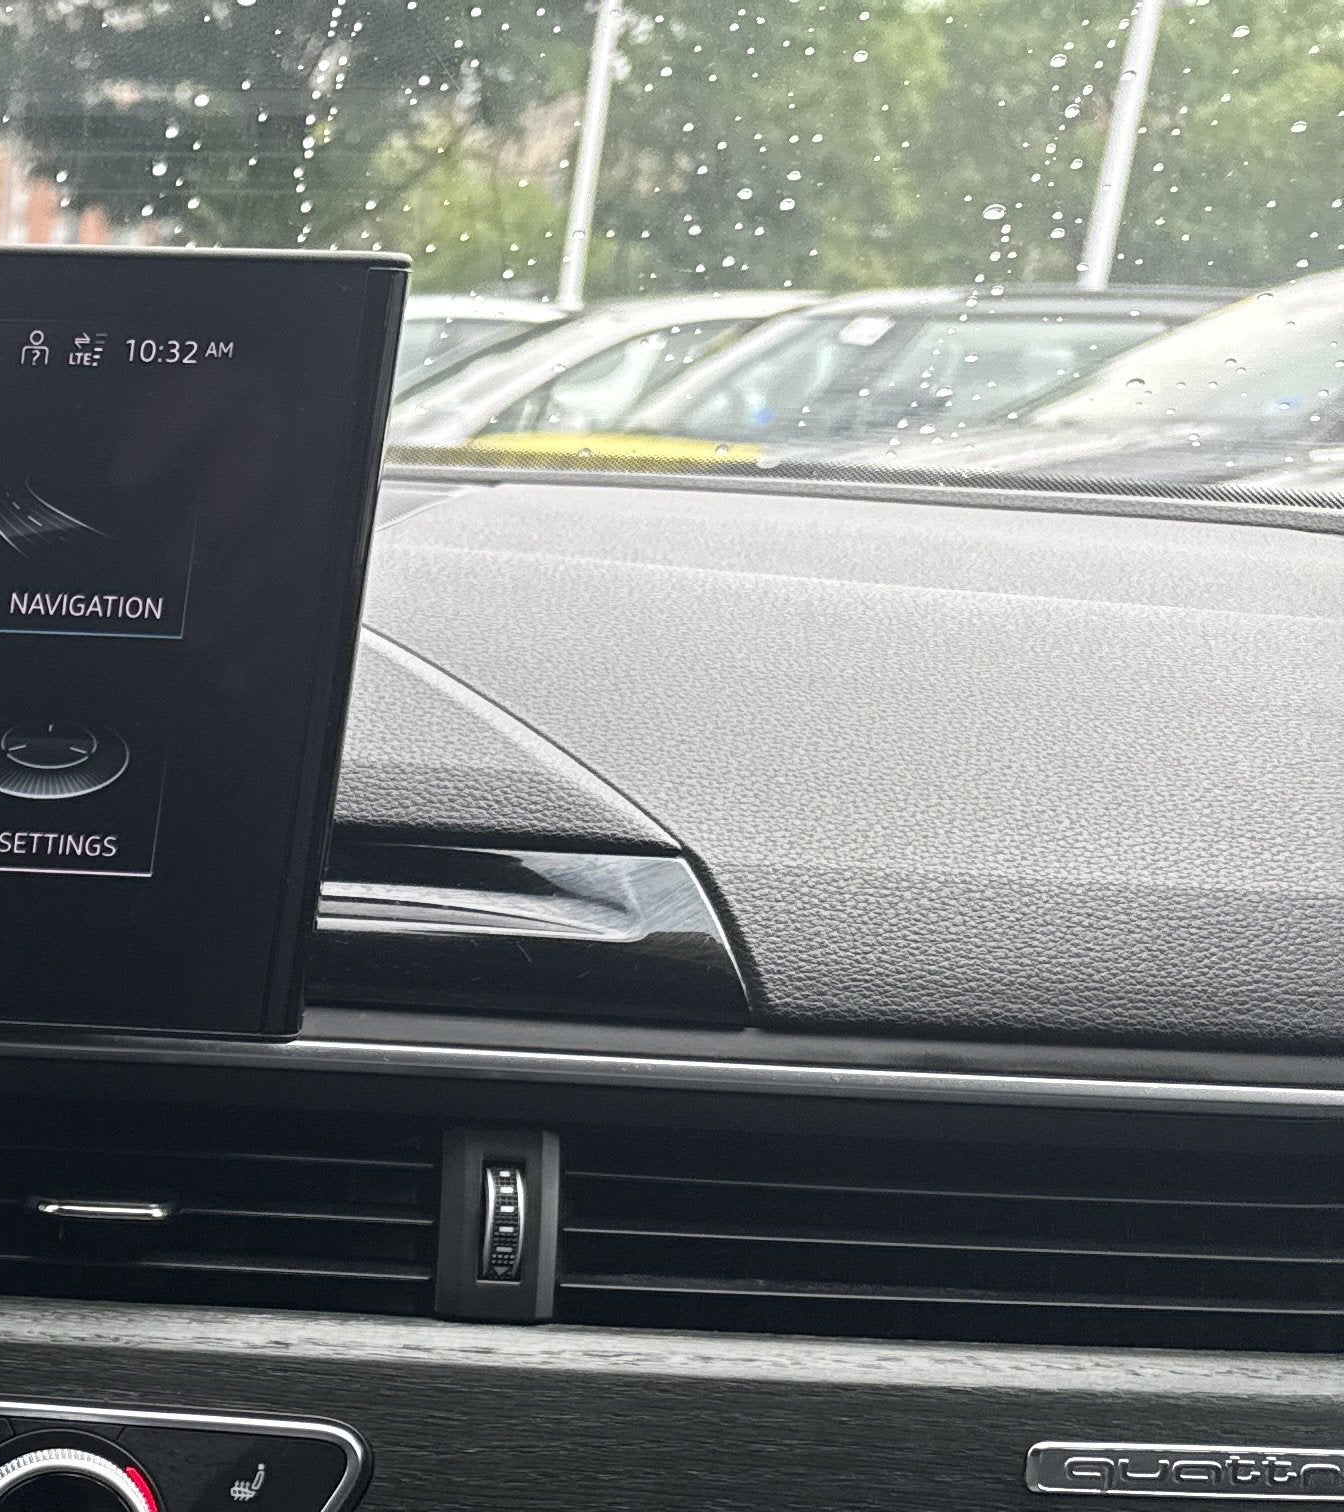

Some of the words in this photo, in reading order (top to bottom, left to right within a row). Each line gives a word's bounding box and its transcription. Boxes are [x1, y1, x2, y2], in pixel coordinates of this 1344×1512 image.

[68, 351, 92, 367] LTE
[125, 339, 199, 364] 10:32
[204, 341, 234, 359] AM
[9, 592, 164, 620] NAVIGATION
